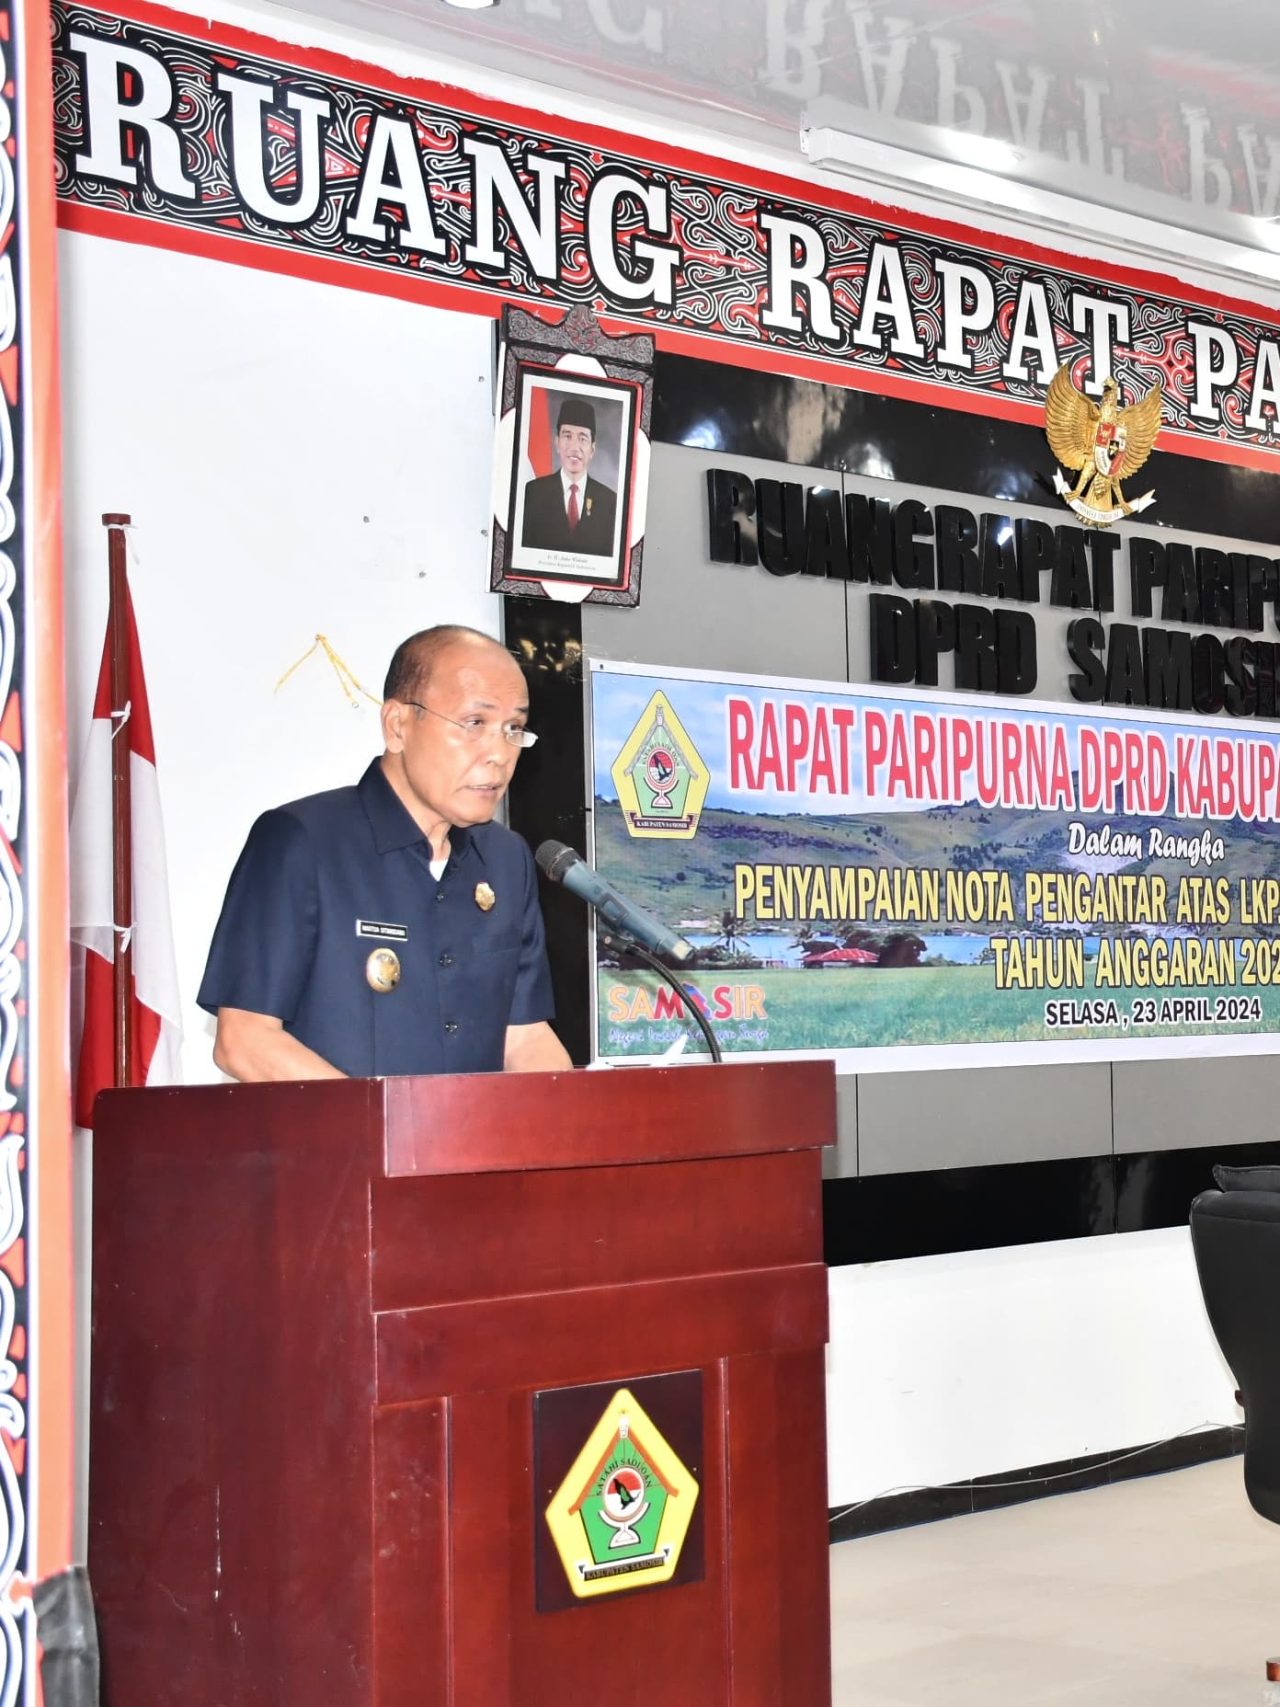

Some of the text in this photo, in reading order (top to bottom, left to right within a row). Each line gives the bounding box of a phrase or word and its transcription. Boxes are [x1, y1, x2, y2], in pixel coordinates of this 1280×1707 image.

[69, 33, 681, 304] RUANG
[759, 213, 1130, 399] RAPAT
[870, 593, 1037, 695] DPRD
[728, 698, 855, 794] RAPAT
[864, 711, 1074, 808] PARIPURNA
[1080, 728, 1168, 813] DPRD
[1068, 822, 1226, 868] Dalam Rangka
[734, 863, 940, 922] PENYAMPAIAN
[945, 869, 1015, 922] NOTA
[1025, 872, 1169, 925] PENGANTAR
[1175, 876, 1230, 925] ATAS
[990, 937, 1085, 990] TAHUN
[1094, 937, 1237, 988] ANGGARAN
[1045, 1000, 1118, 1026] SELASA
[1133, 999, 1157, 1024] 23
[1160, 999, 1212, 1023] APRIL
[1216, 998, 1261, 1021] 2024
